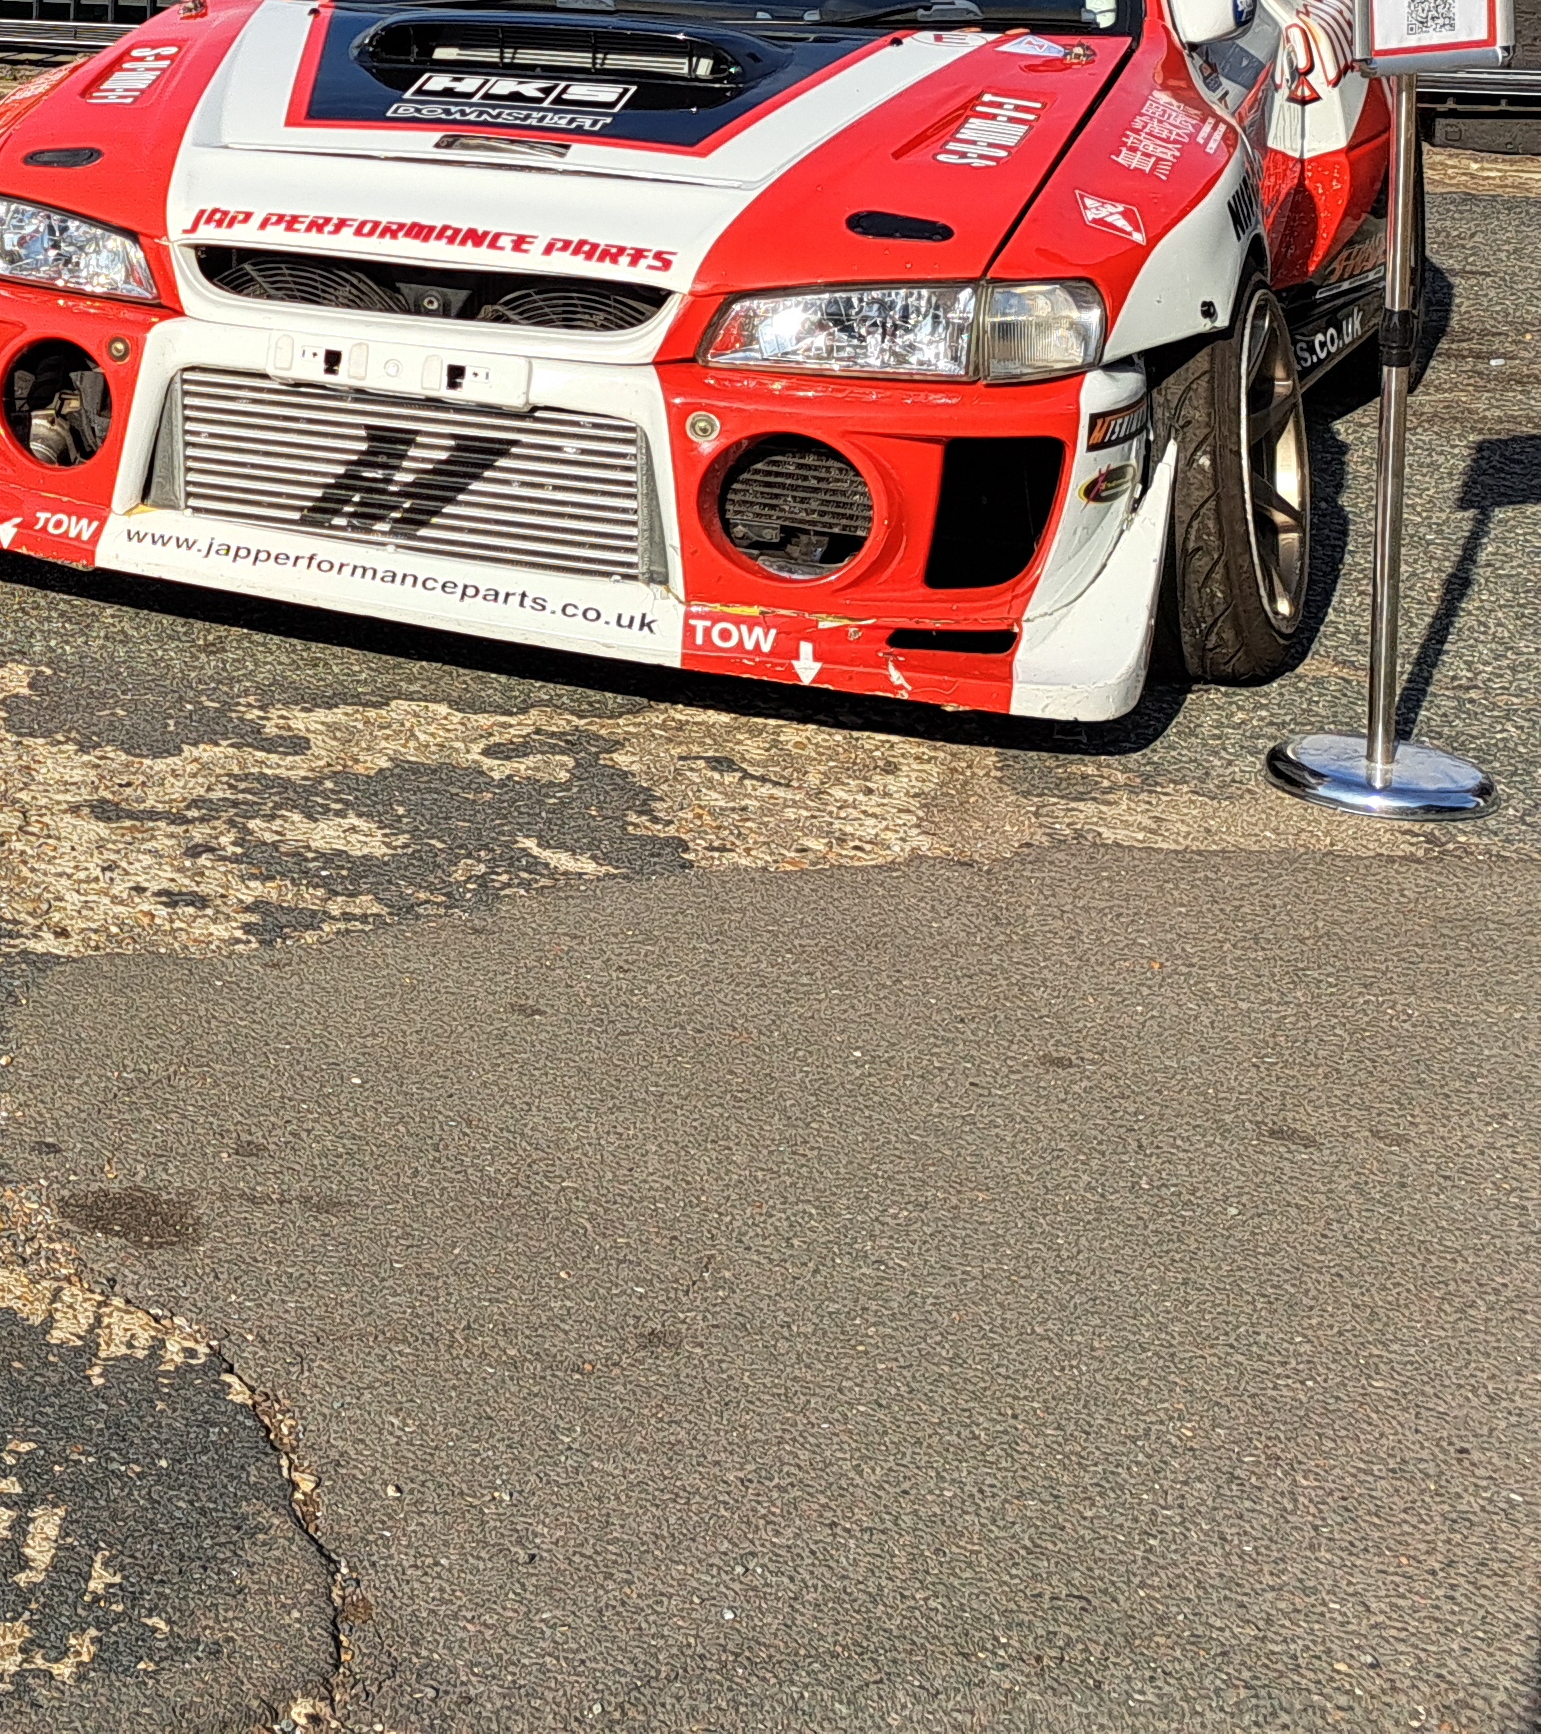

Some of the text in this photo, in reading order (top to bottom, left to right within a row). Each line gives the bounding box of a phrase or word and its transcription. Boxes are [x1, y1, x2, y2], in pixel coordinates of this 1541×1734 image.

[421, 75, 624, 103] HKS
[386, 103, 613, 131] DOWNSHIFT
[182, 207, 681, 273] JAP PERFORMANCE PARTS
[34, 511, 100, 542] TOW
[125, 526, 661, 635] www.japperformanceparts.co.uk
[688, 618, 778, 654] TOW
